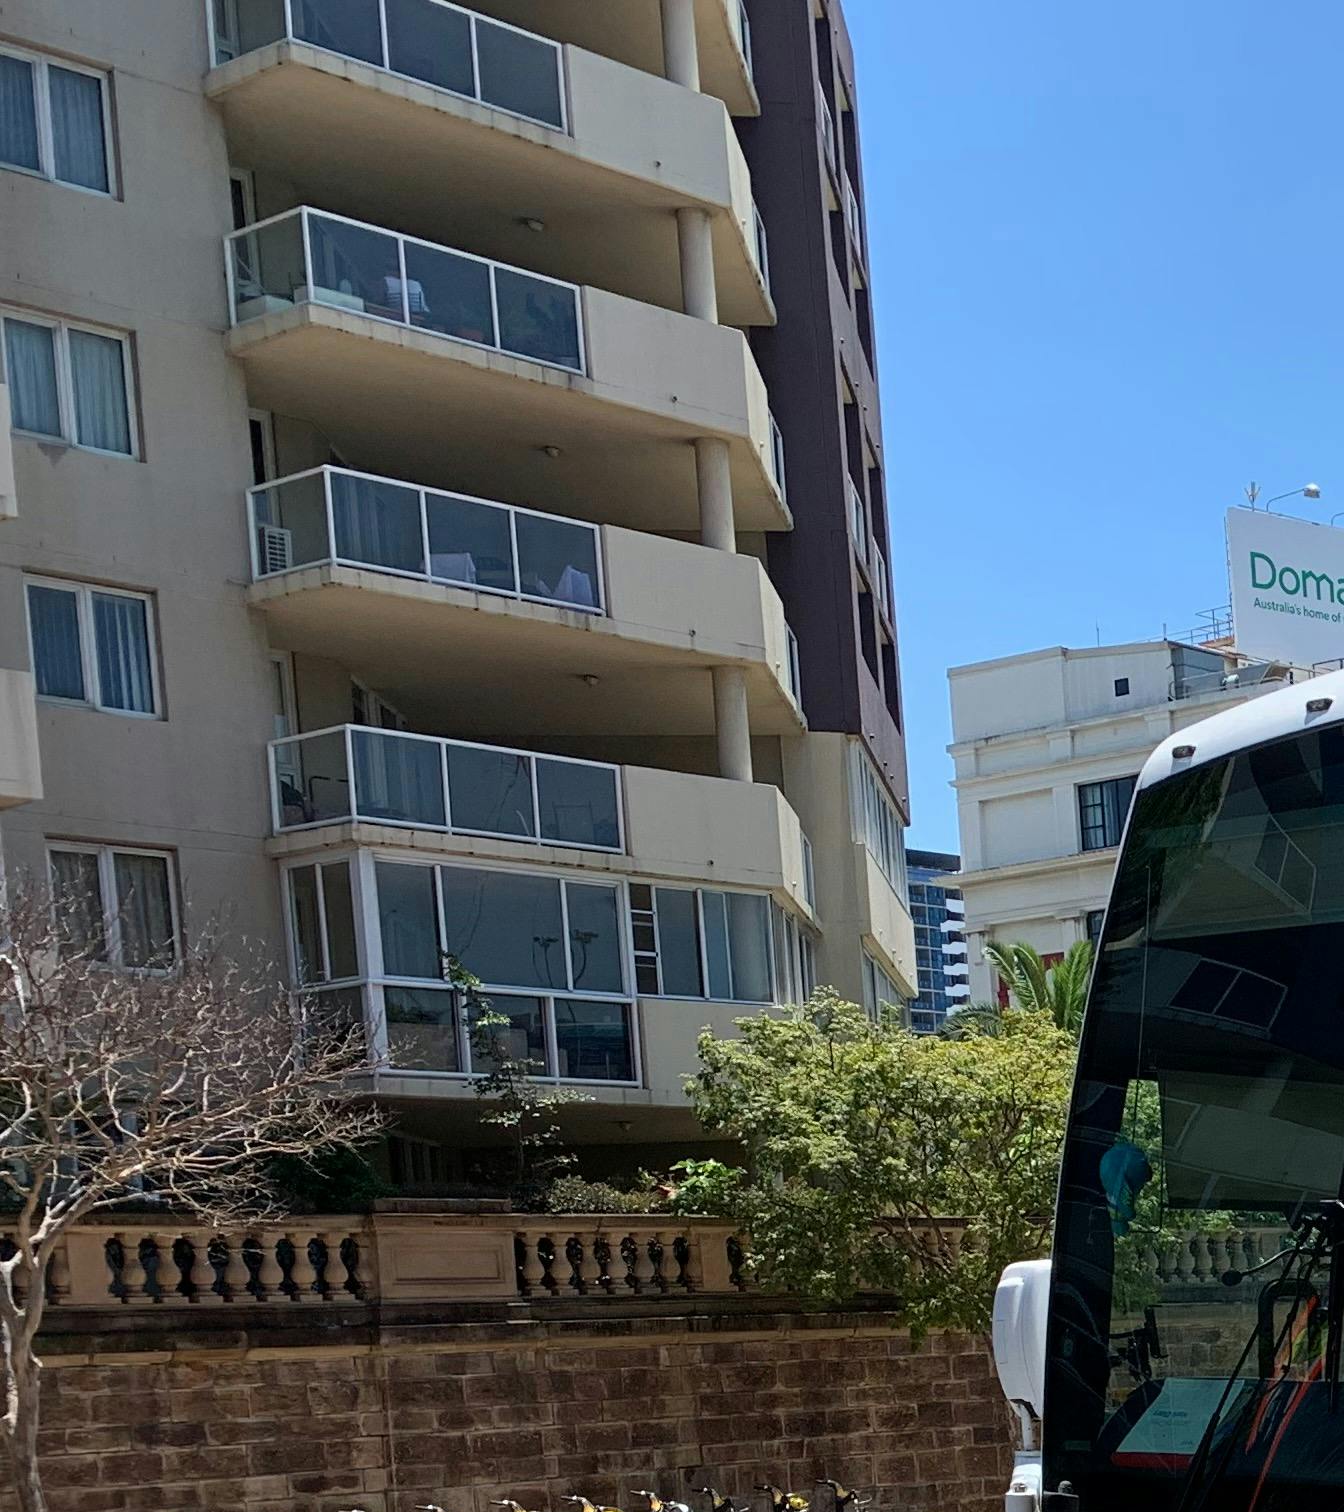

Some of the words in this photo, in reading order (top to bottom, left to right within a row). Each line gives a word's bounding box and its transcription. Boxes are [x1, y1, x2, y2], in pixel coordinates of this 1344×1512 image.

[1253, 596, 1302, 617] Australia's
[1303, 607, 1330, 622] home
[1331, 610, 1343, 624] of
